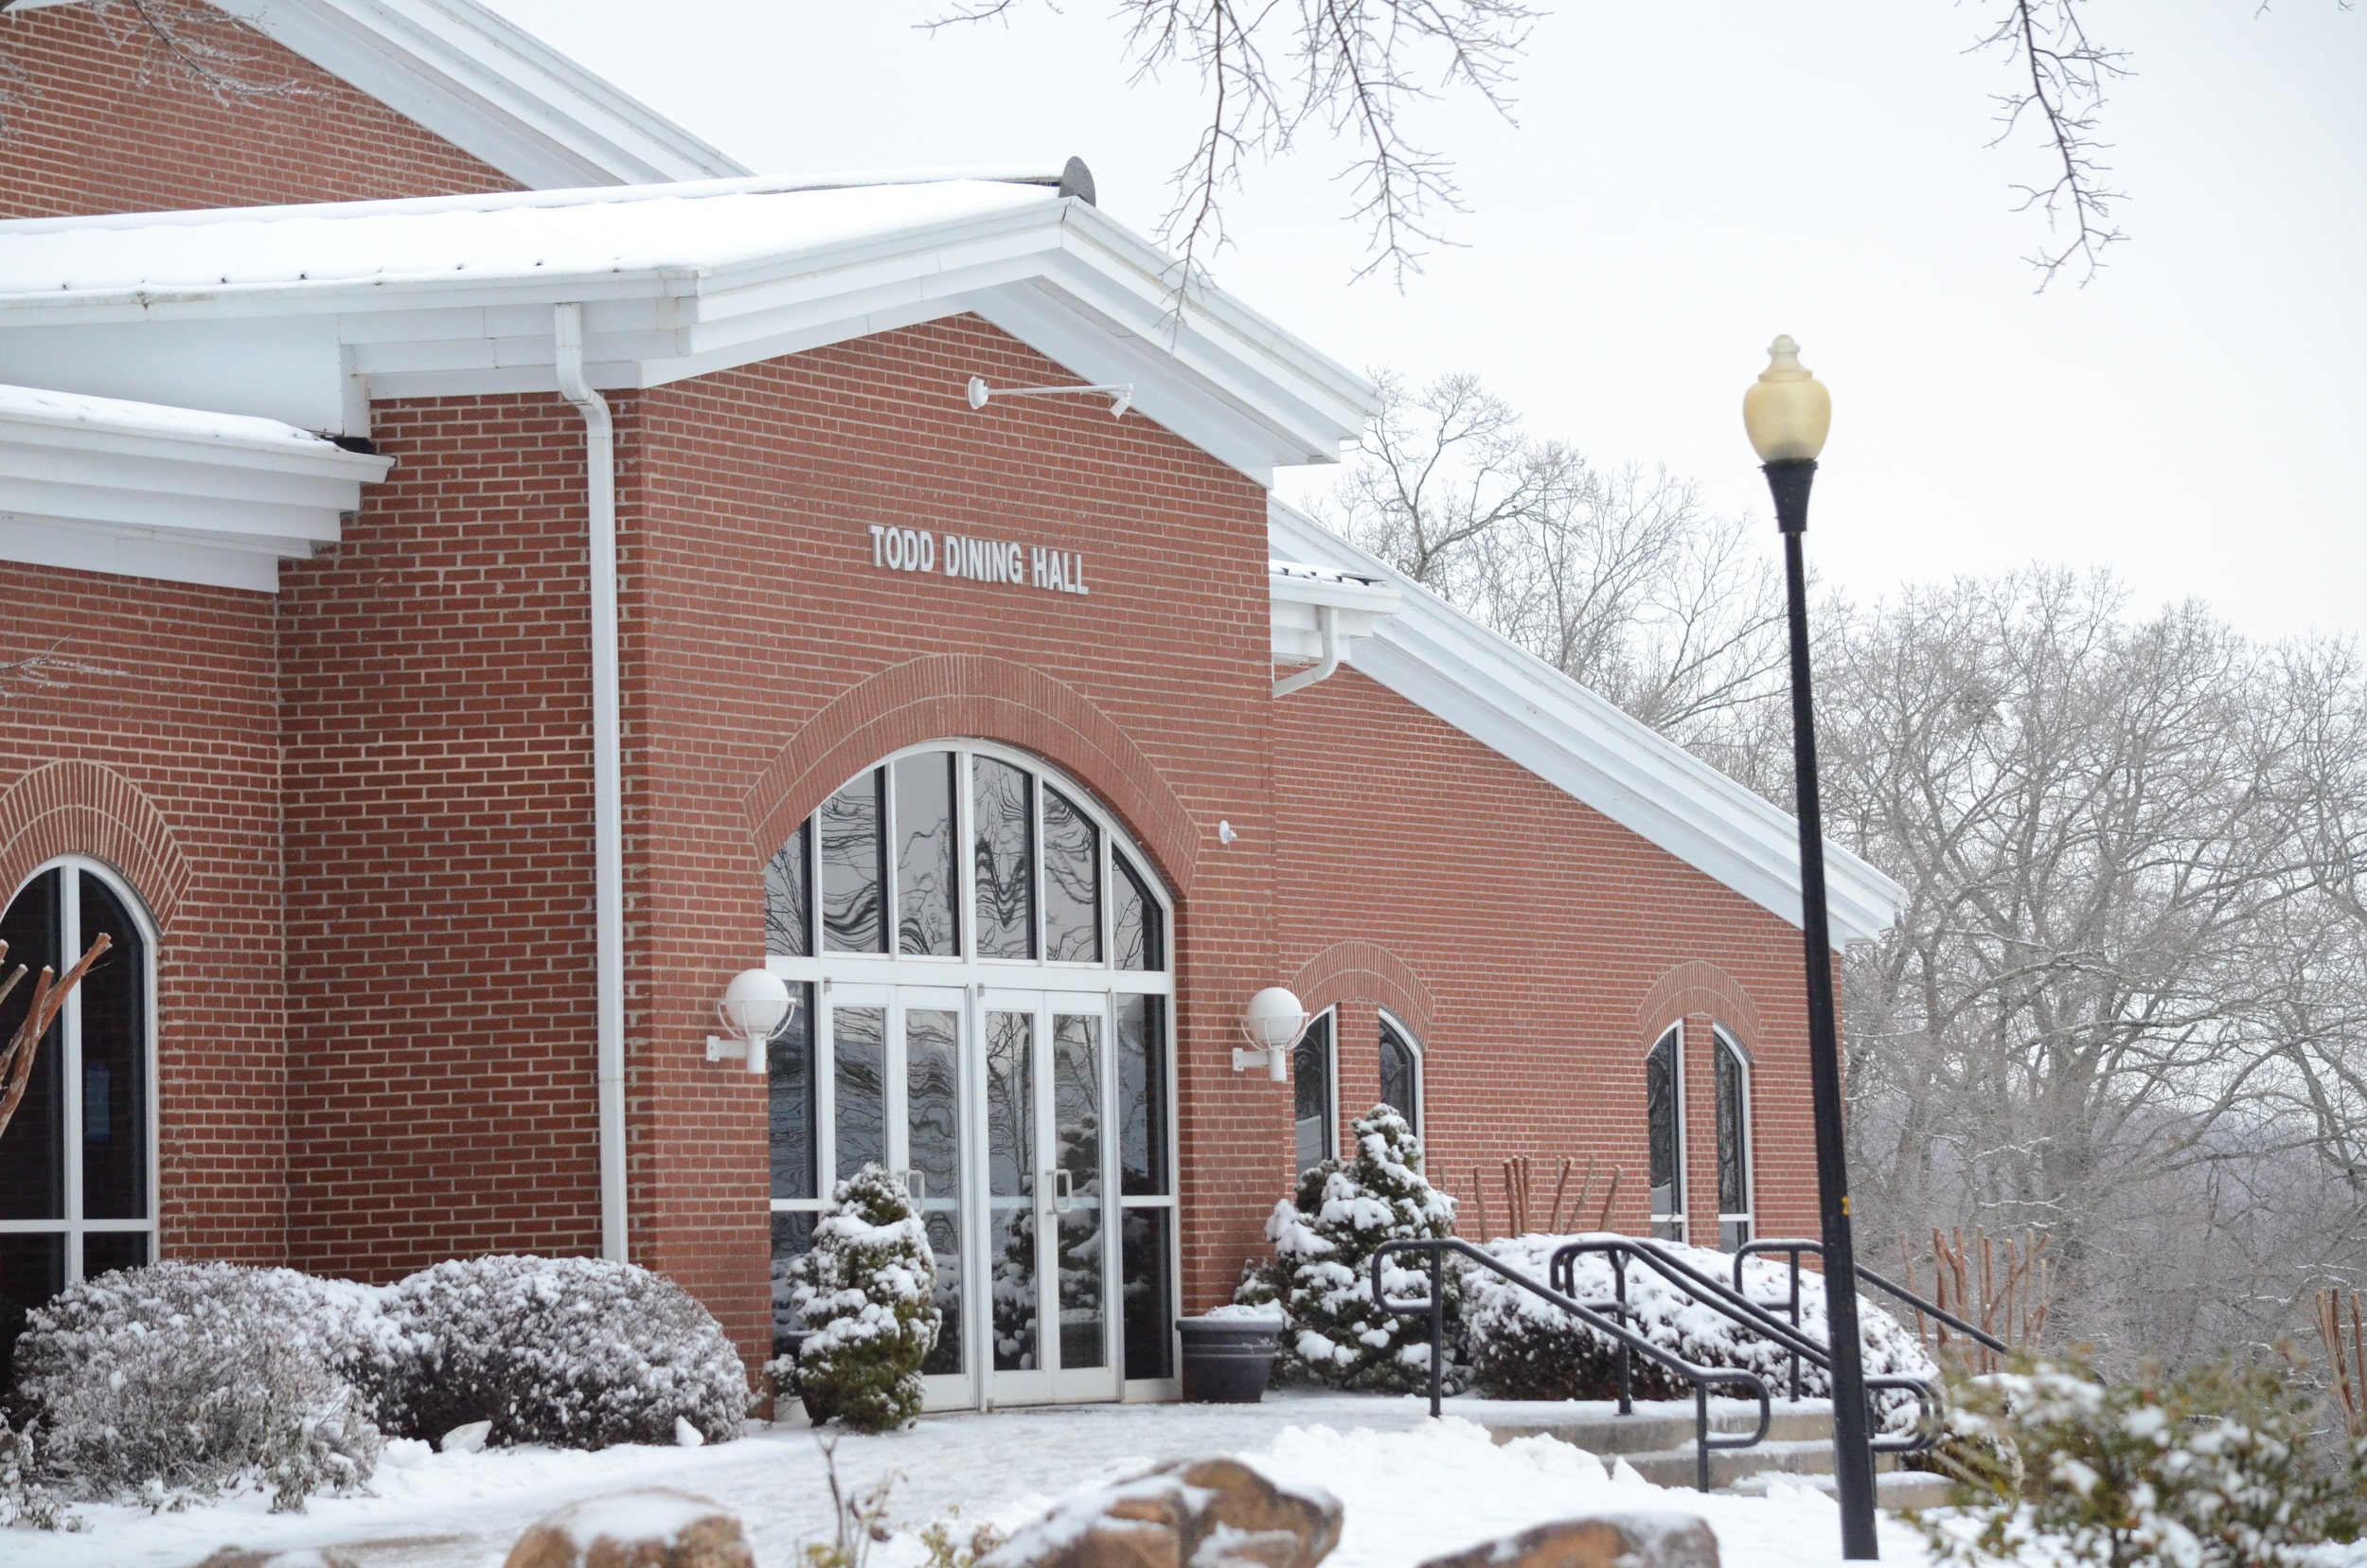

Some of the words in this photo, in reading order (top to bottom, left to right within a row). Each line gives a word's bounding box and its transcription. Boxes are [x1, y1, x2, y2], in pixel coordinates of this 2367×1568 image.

[868, 526, 934, 572] TODD
[944, 535, 1023, 584] DINING
[1030, 546, 1089, 595] HALL
